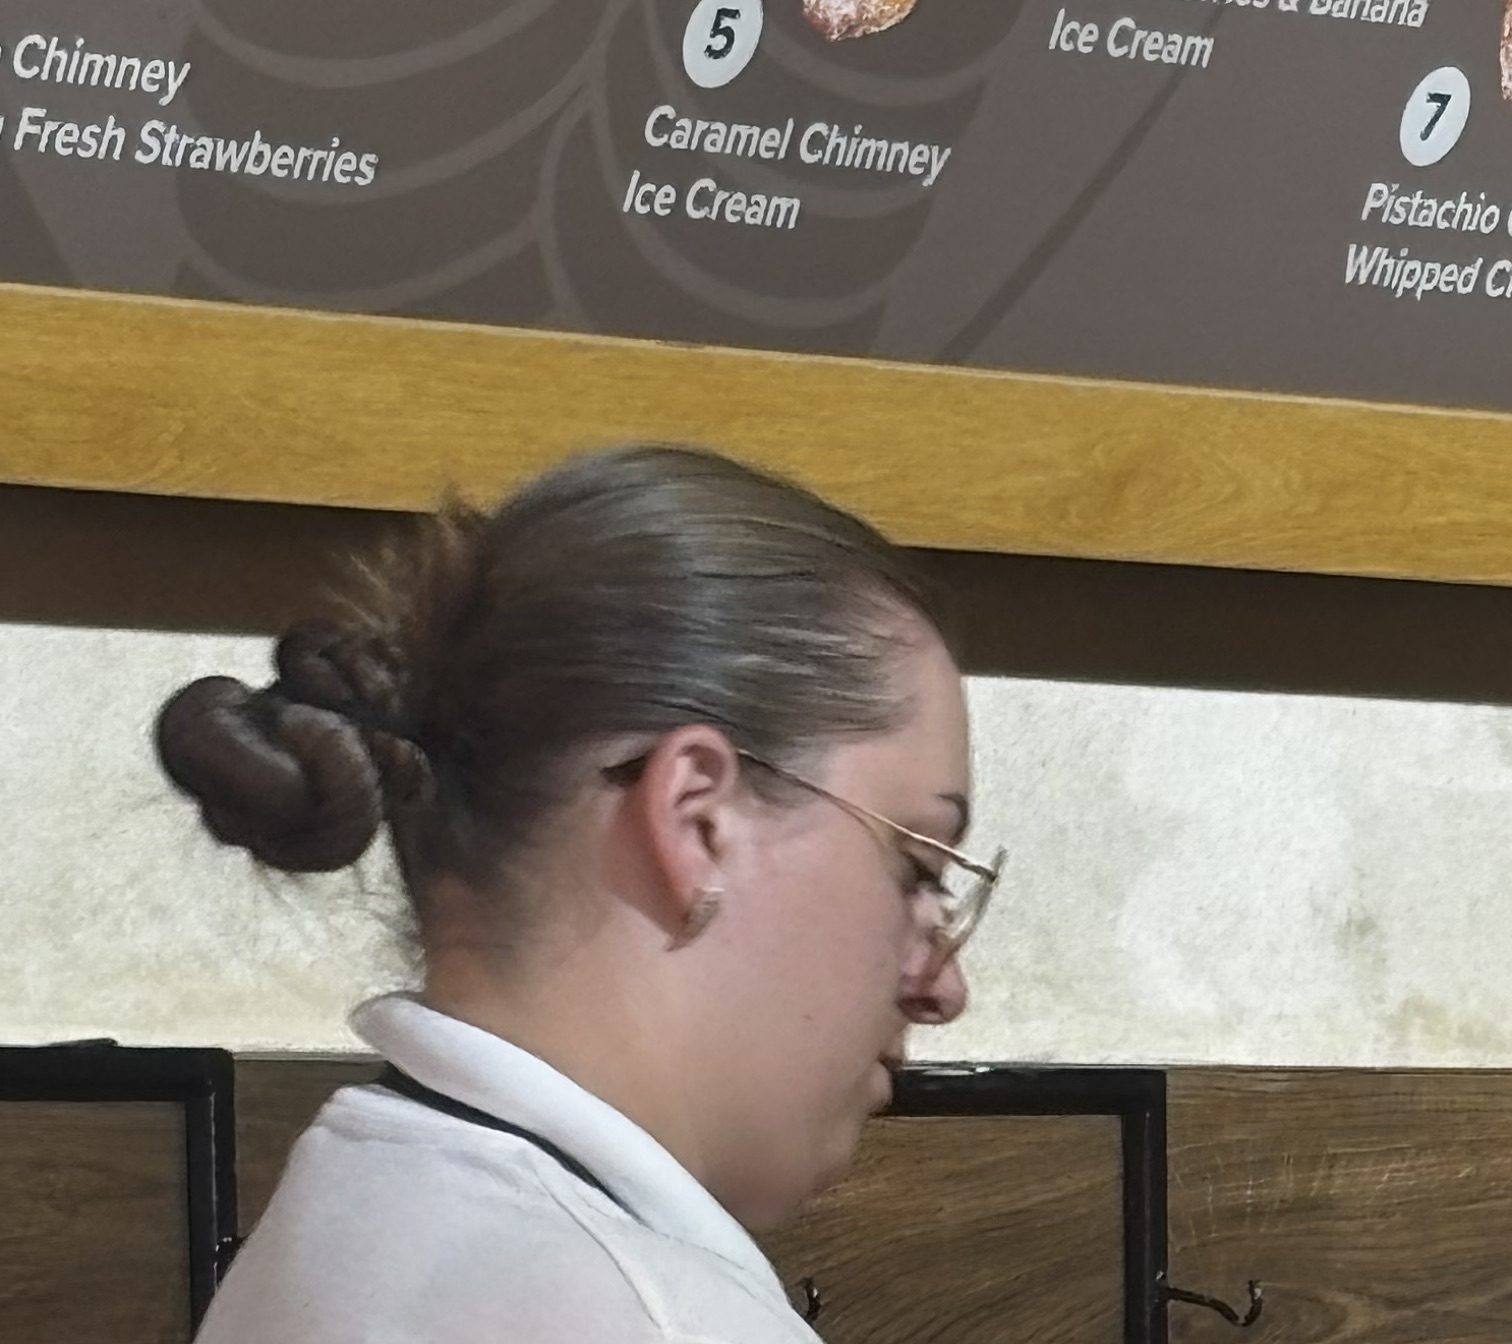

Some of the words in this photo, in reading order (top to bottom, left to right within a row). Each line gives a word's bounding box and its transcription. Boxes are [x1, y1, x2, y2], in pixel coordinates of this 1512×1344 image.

[704, 8, 741, 60] 5
[1048, 8, 1100, 54] Ice
[1107, 17, 1215, 69] Cream
[13, 34, 192, 106] Chimney
[644, 104, 796, 161] Caramel
[799, 120, 951, 187] Chimney
[1420, 92, 1452, 140] 7
[13, 107, 126, 161] Fresh
[134, 119, 380, 187] Strawberries
[623, 169, 676, 216] Ice
[685, 177, 800, 230] Cream
[1361, 181, 1501, 238] Pistachio
[1344, 243, 1481, 300] Whipped
